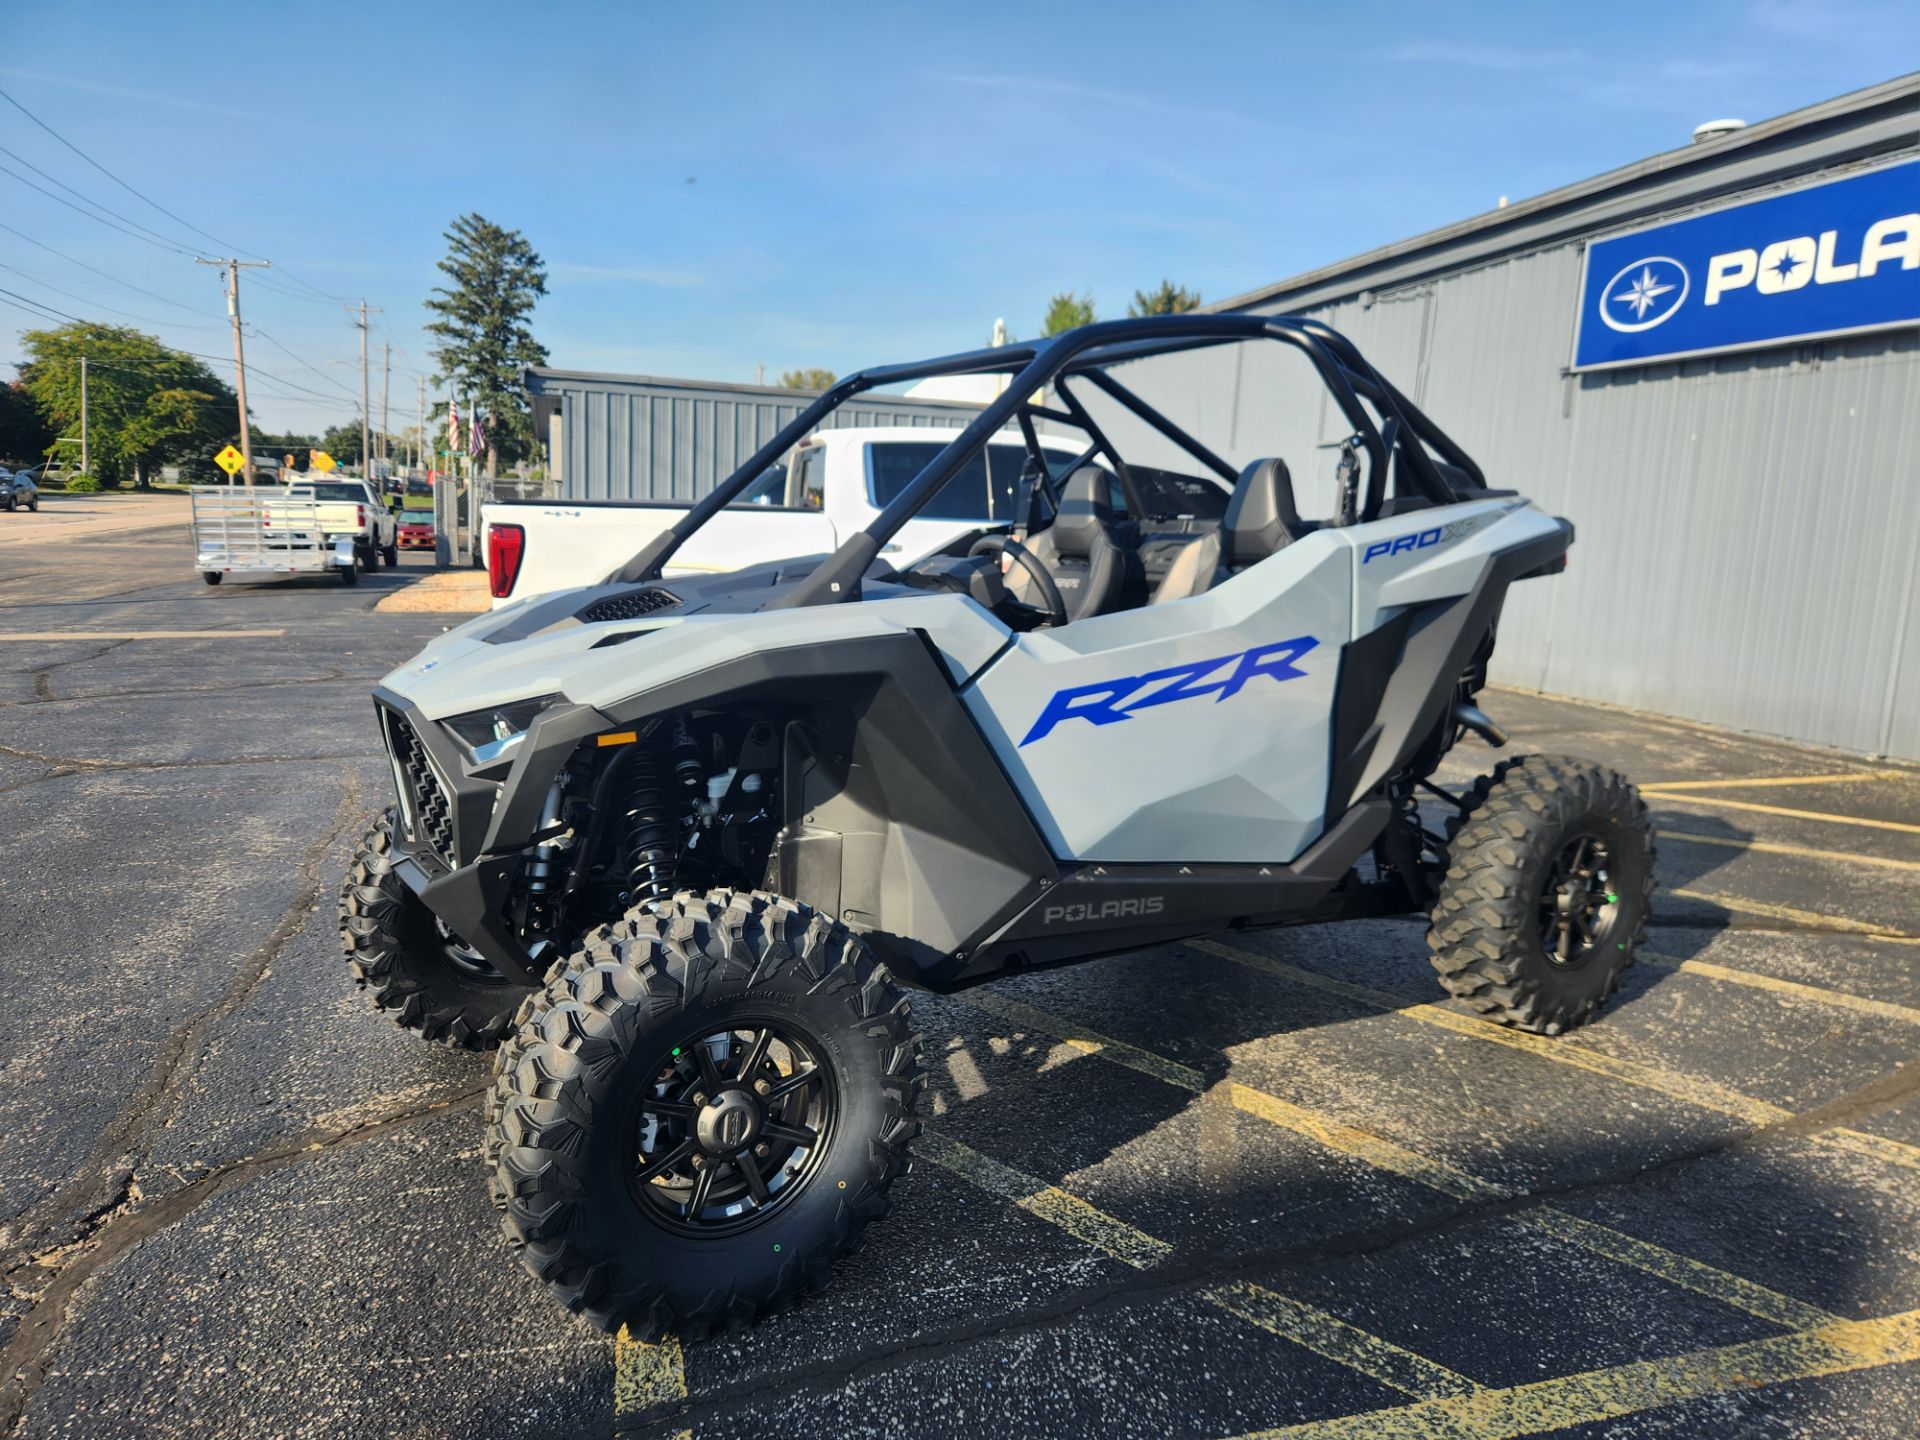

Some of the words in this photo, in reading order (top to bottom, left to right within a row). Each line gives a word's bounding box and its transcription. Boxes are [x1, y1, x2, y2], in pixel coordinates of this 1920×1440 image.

[1704, 213, 1920, 306] POLA
[1363, 527, 1442, 564] PRO
[1017, 635, 1321, 749] RZR
[1043, 896, 1164, 924] POLARIS
